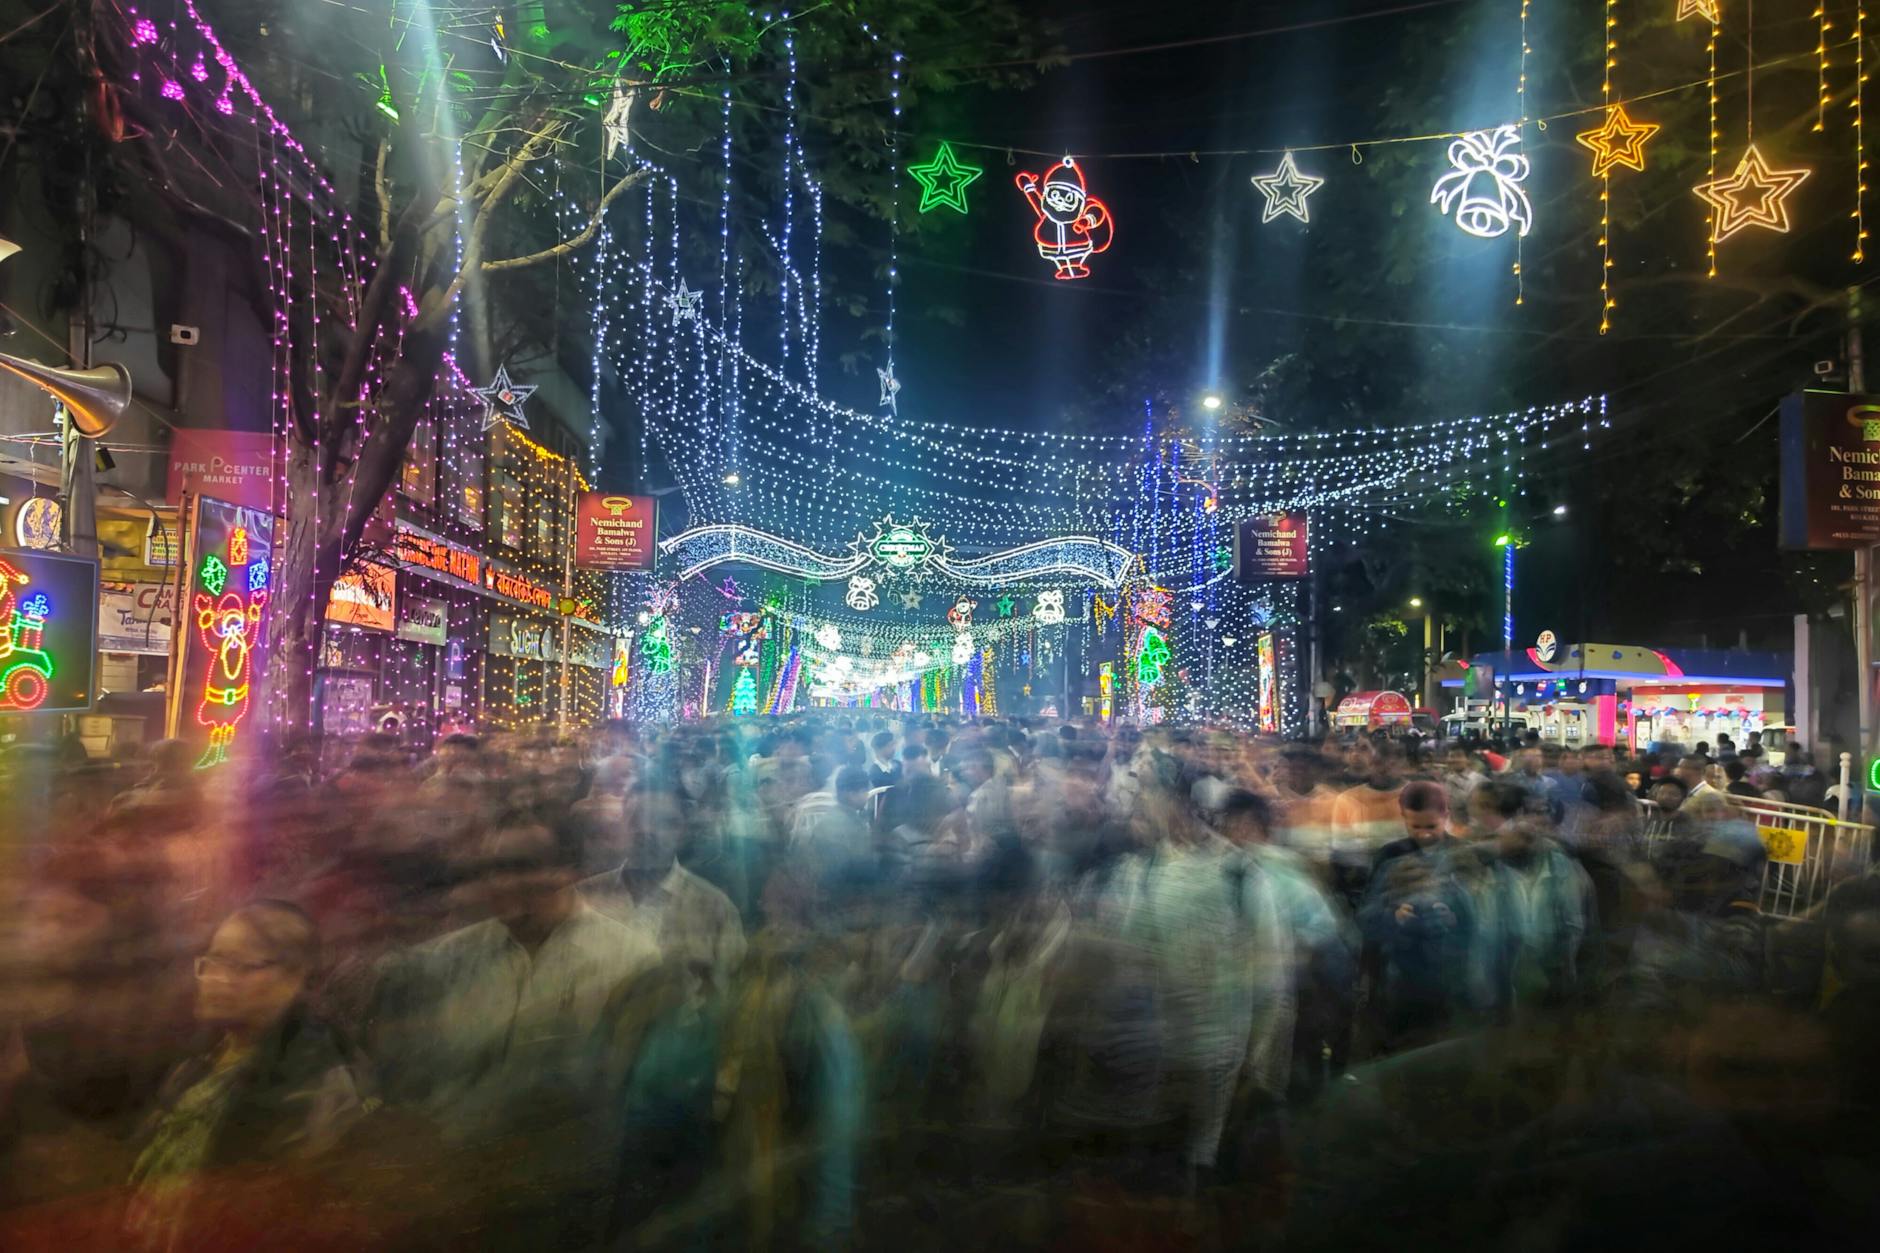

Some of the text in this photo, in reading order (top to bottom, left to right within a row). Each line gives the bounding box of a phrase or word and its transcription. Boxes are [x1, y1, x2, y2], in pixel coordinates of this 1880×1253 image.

[1829, 445, 1880, 464] Nemic
[174, 462, 206, 473] PARK
[223, 465, 270, 476] CENTER
[203, 475, 243, 484] MARKET
[1839, 483, 1852, 498] &
[590, 517, 643, 528] Nemichand
[597, 527, 635, 537] Bamalwa
[1251, 529, 1297, 539] Nemichand
[594, 536, 637, 547] & Sons (J)
[1255, 547, 1263, 556] &
[1264, 547, 1281, 556] Sons
[1540, 633, 1551, 643] HP
